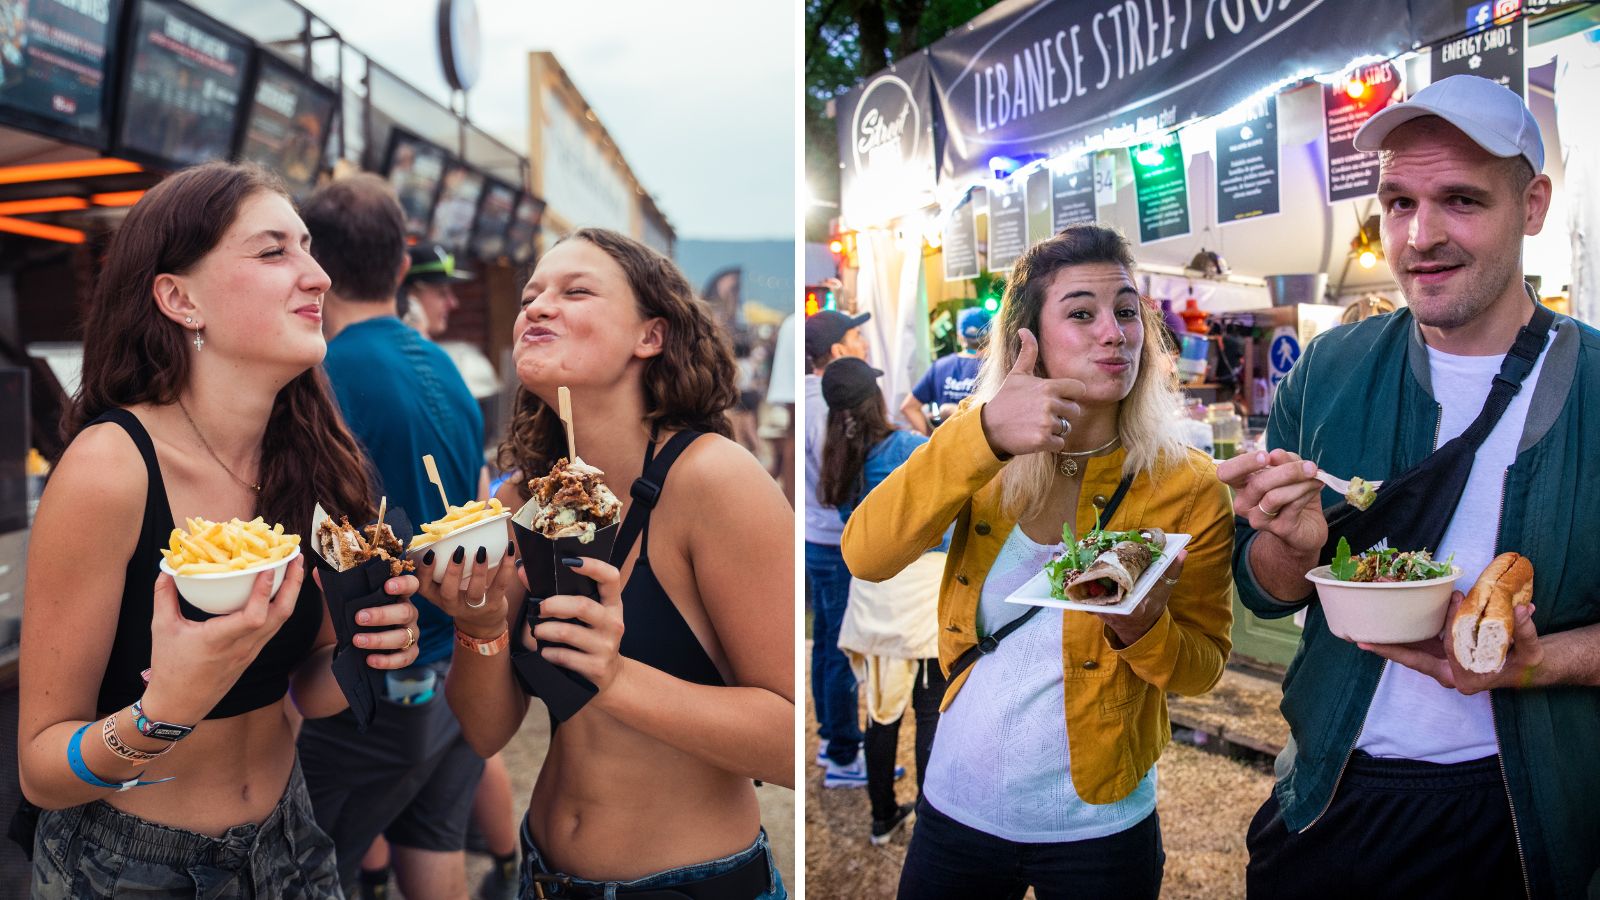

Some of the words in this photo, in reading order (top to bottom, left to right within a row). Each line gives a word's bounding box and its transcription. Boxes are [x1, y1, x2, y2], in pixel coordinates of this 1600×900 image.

[974, 25, 1087, 134] LEBANESE
[1442, 34, 1483, 63] ENERGY
[1484, 26, 1512, 51] SHOT
